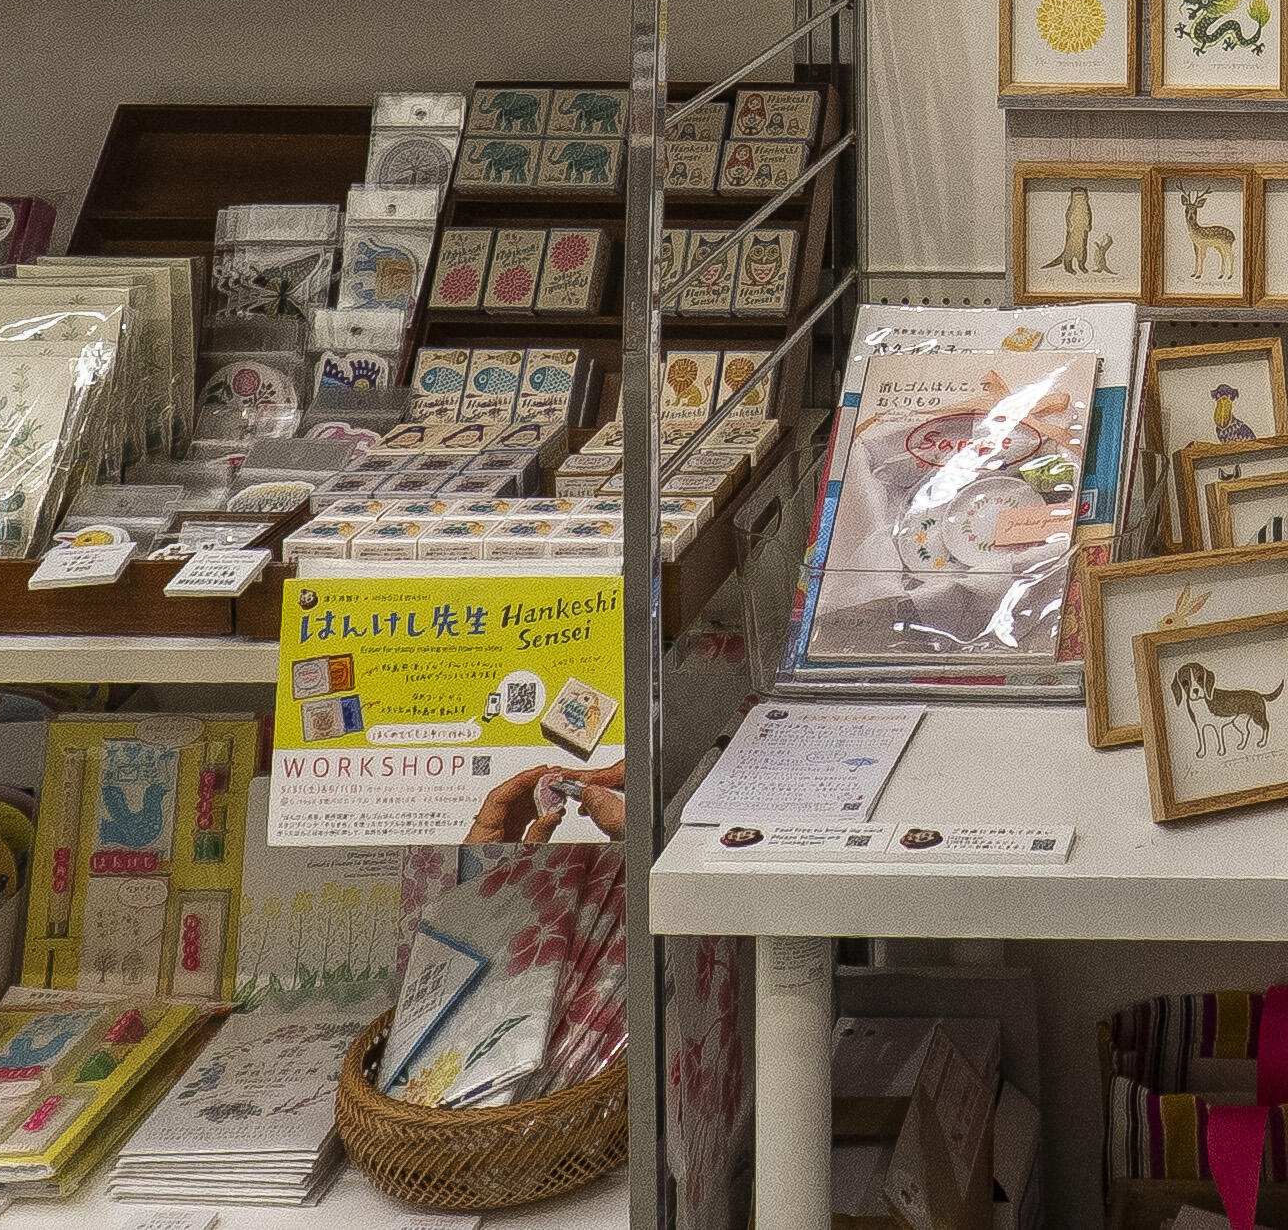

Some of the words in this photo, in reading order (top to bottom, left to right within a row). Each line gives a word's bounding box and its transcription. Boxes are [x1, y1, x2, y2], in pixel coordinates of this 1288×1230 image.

[878, 380, 992, 394] 消しゴムはんこ。で
[876, 396, 941, 407] おくりもの
[501, 589, 618, 628] Hankeshi
[300, 604, 489, 644] はんけし先生
[517, 619, 592, 651] Sensei
[283, 755, 466, 779] WORKSHOP
